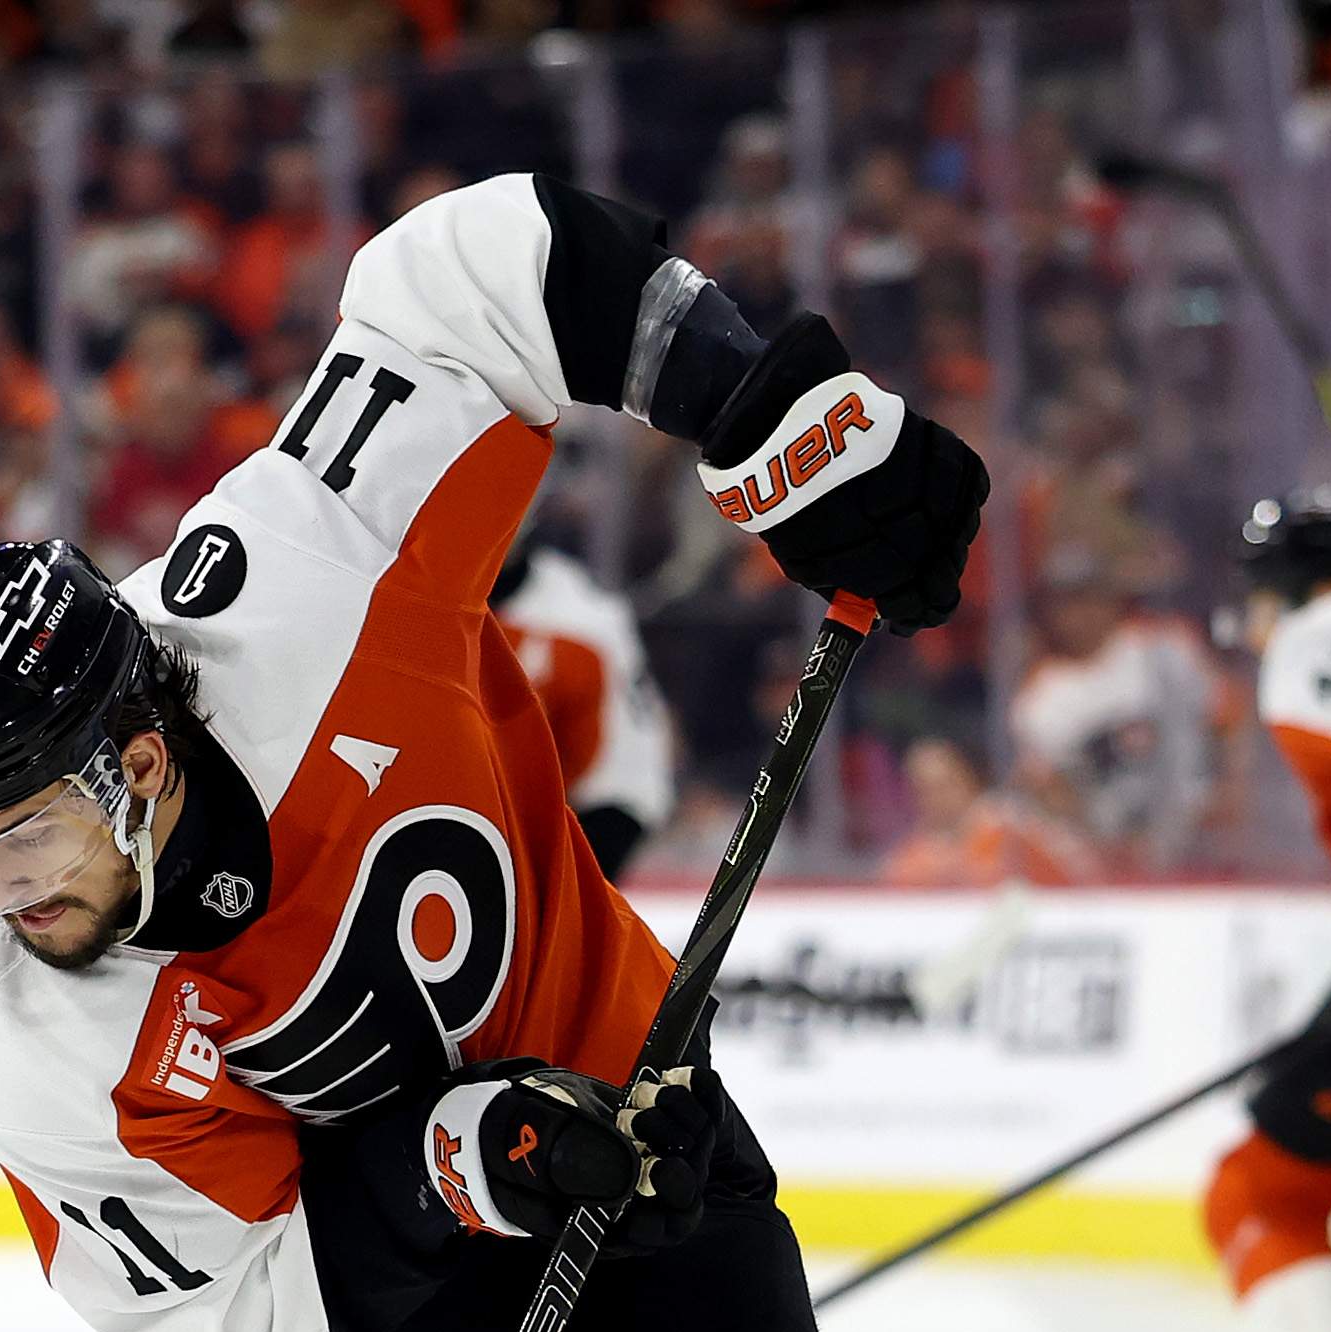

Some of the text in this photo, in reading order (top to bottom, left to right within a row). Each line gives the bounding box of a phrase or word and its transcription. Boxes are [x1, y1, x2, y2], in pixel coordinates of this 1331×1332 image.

[278, 352, 417, 494] 11
[709, 392, 874, 525] AUER
[17, 579, 76, 676] CHEVROLET
[222, 880, 236, 910] NHL
[59, 1195, 215, 1297] 11
